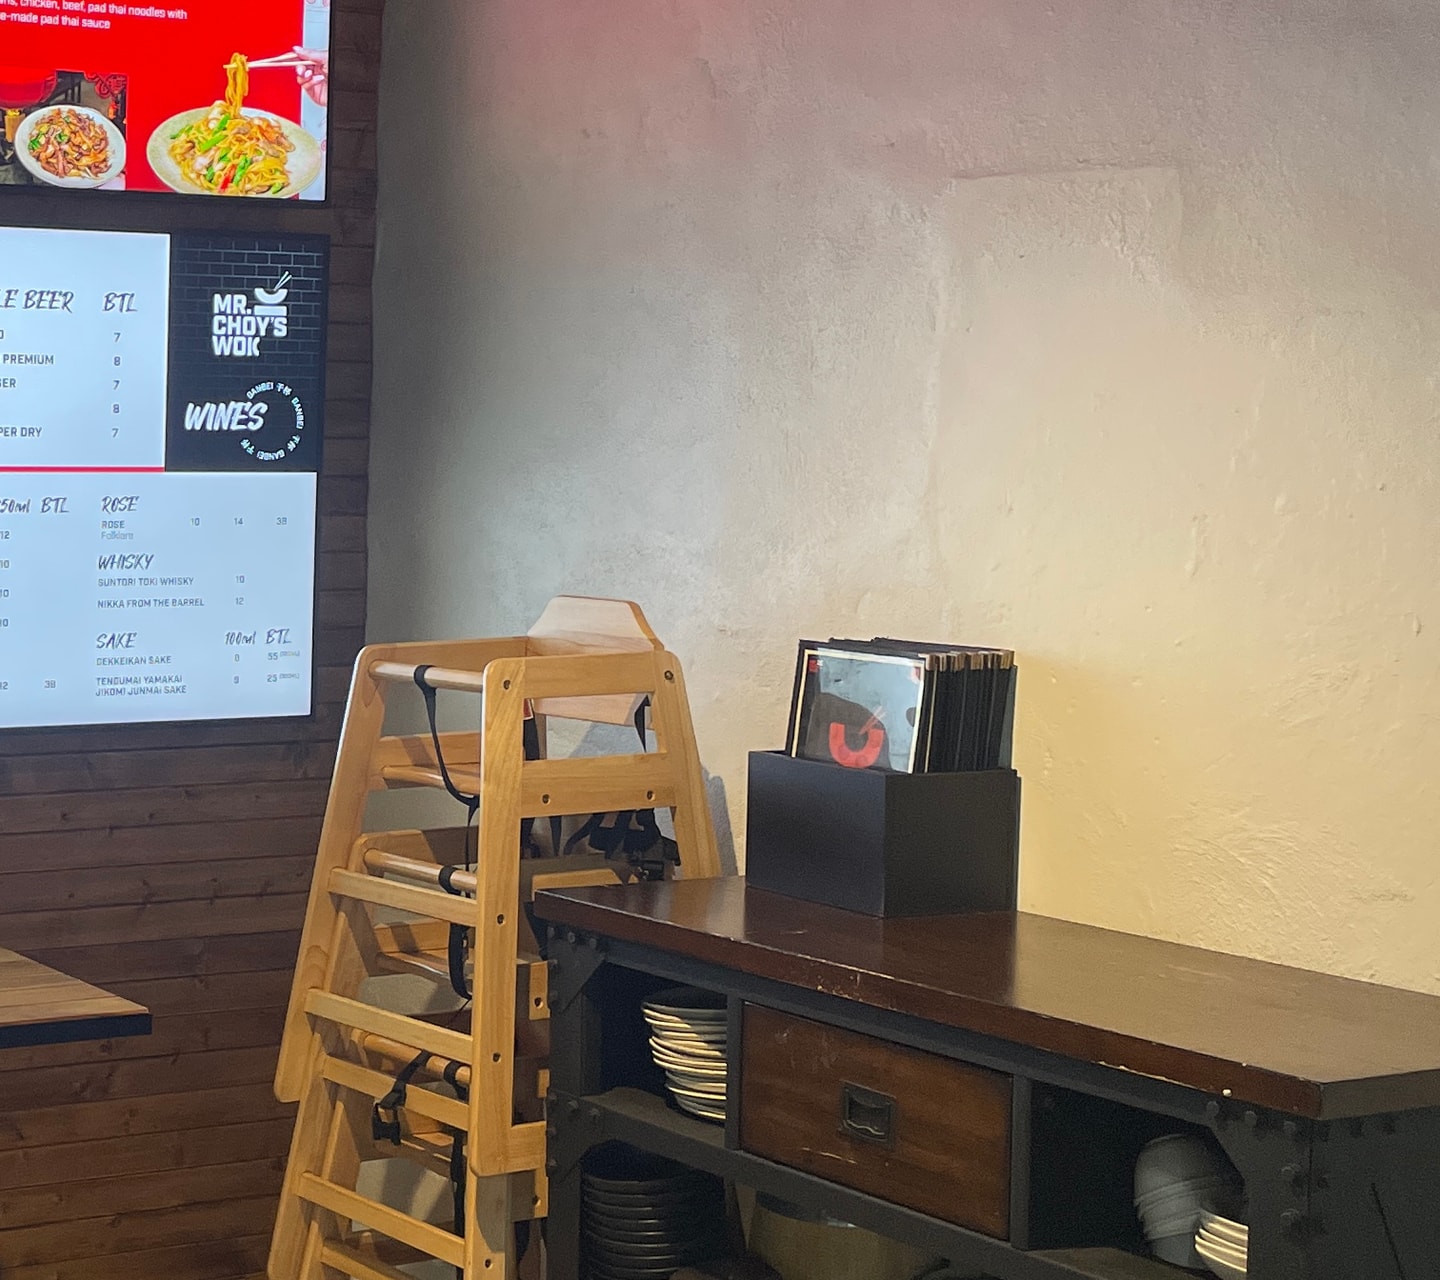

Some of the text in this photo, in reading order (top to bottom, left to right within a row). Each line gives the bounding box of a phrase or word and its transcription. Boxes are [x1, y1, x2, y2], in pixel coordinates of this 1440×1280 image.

[22, 289, 74, 313] BEER
[103, 292, 137, 313] BTL
[213, 293, 251, 314] MR.
[212, 314, 287, 337] CHOY'S
[113, 332, 121, 342] 7
[211, 335, 260, 356] WOK
[2, 353, 54, 365] PREMIUM
[113, 379, 120, 390] 7
[184, 400, 268, 431] WINES
[20, 426, 42, 437] DRY
[111, 427, 119, 438] 7
[40, 496, 69, 513] BTL
[101, 495, 139, 514] ROSE
[101, 520, 125, 529] ROSE
[98, 553, 154, 570] WHISKY
[96, 632, 137, 650] SAKE
[265, 628, 291, 644] BTL
